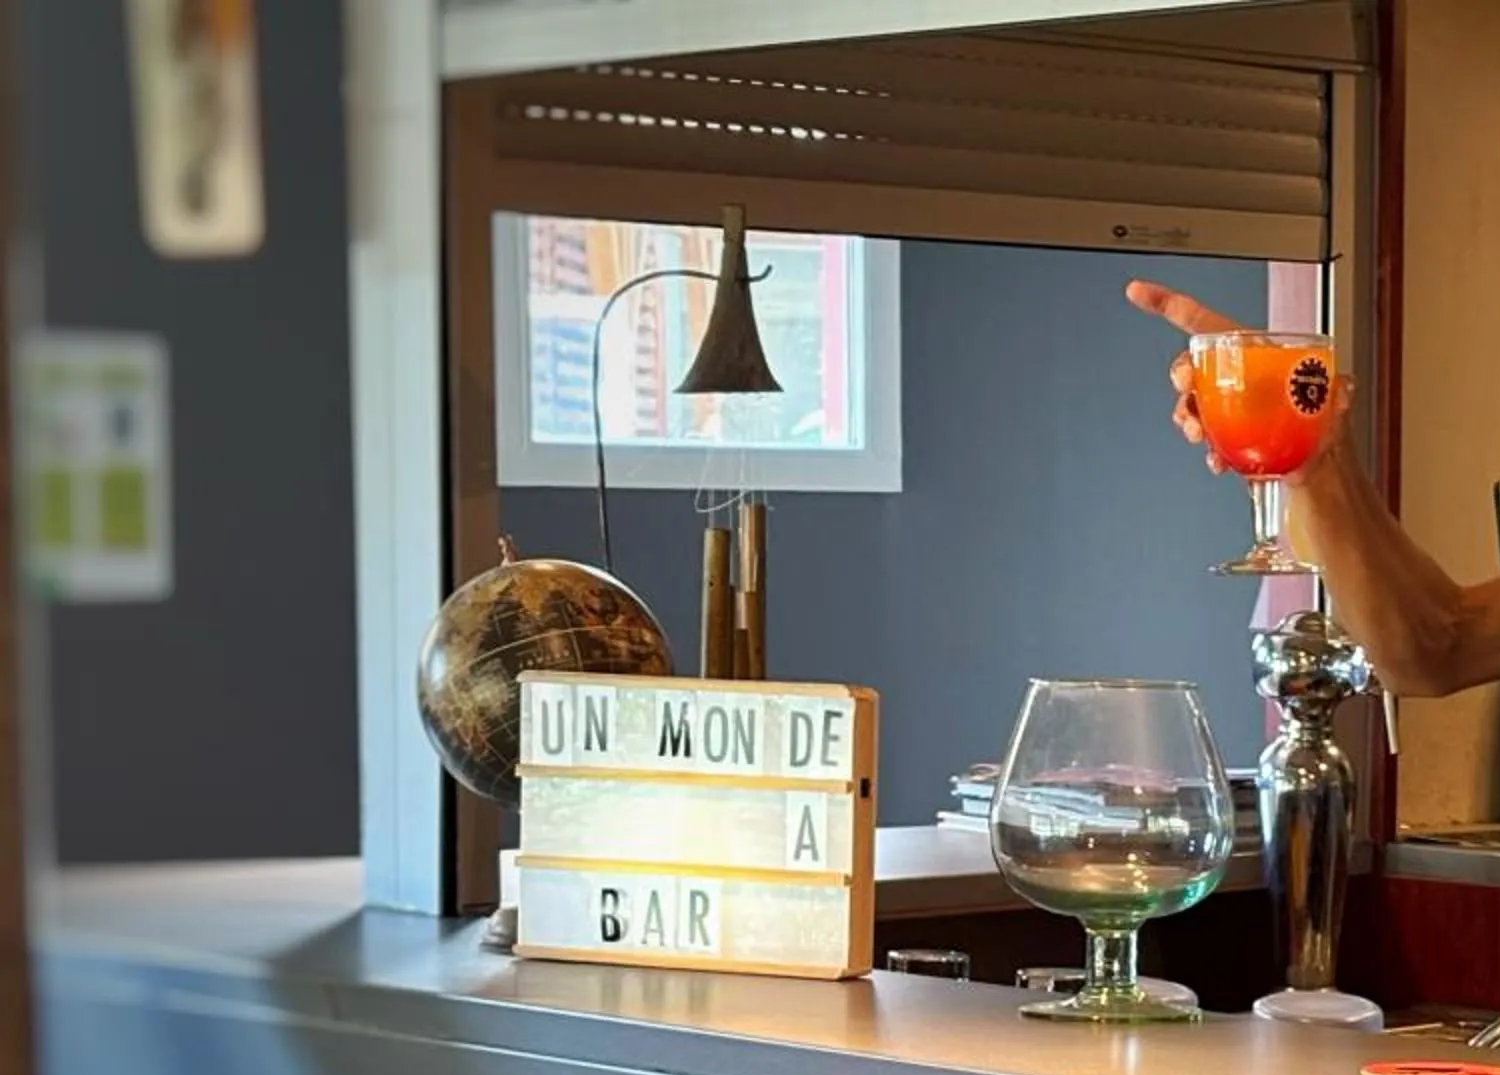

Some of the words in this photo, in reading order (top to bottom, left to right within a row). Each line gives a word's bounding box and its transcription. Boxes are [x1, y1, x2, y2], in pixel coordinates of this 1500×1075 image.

[541, 696, 608, 756] UN
[793, 804, 820, 862] A
[601, 887, 711, 948] BAR
